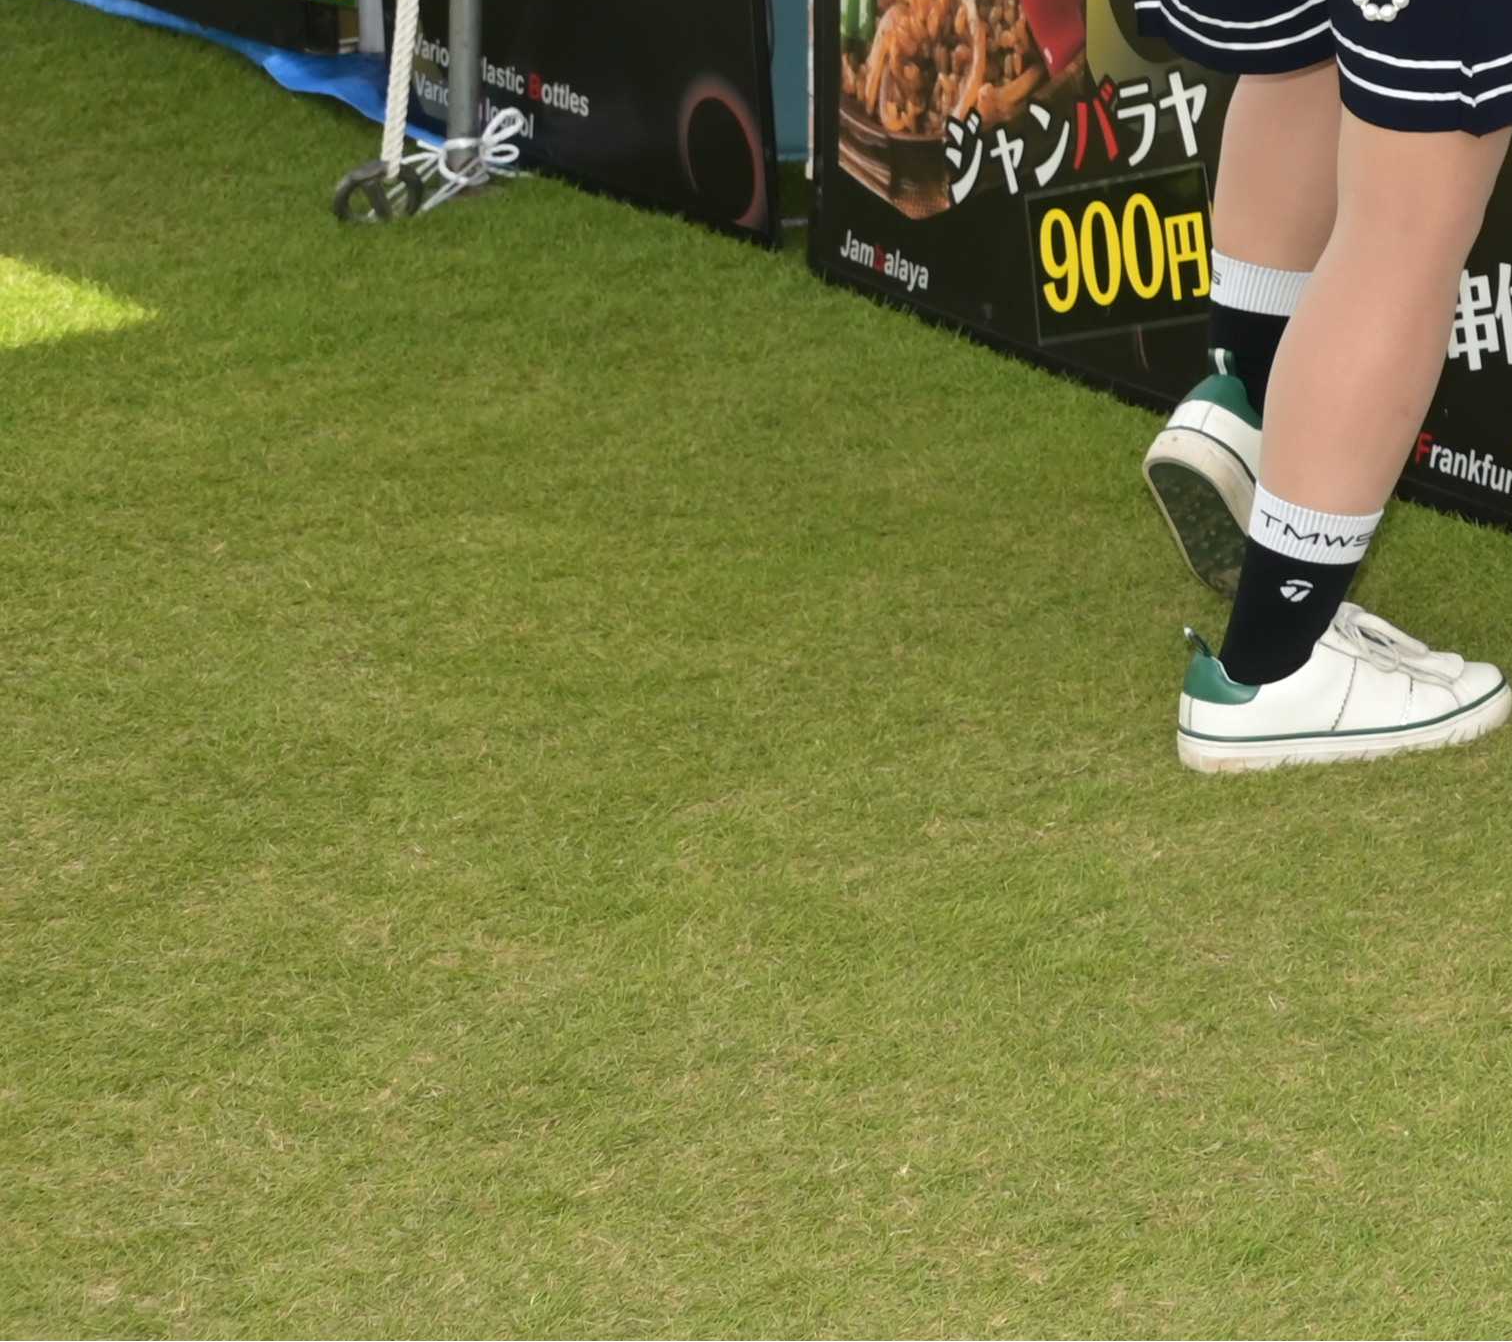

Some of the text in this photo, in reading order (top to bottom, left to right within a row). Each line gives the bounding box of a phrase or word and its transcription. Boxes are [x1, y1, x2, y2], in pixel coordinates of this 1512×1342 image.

[481, 56, 525, 96] lastic
[528, 73, 590, 118] Bottles
[945, 70, 1208, 206] ジャンバラヤ
[840, 229, 930, 293] Jambalaya
[1039, 193, 1211, 314] 900円
